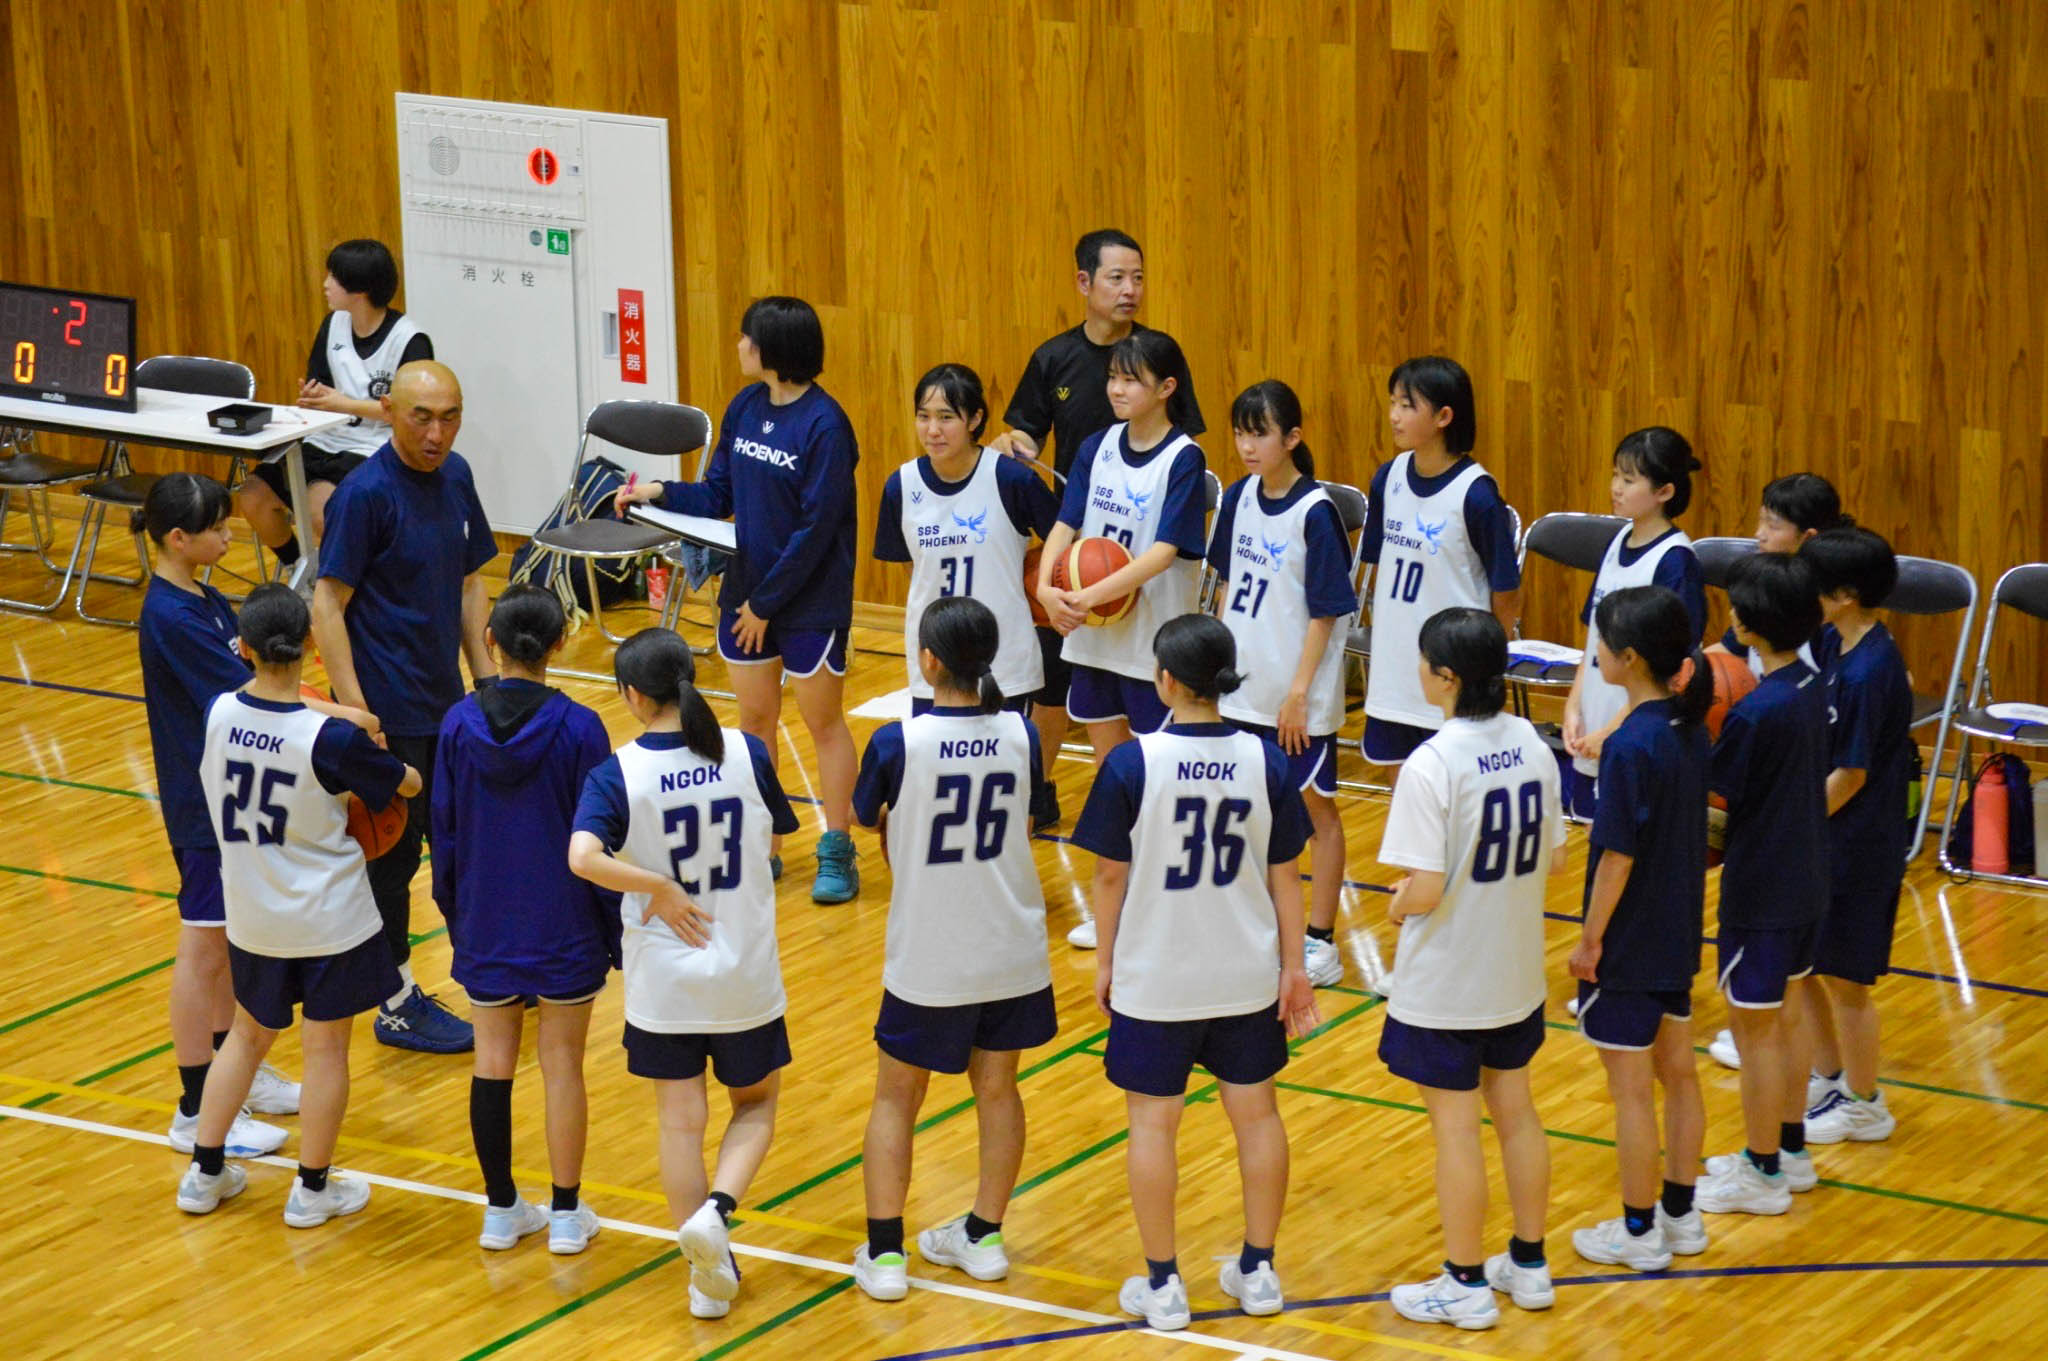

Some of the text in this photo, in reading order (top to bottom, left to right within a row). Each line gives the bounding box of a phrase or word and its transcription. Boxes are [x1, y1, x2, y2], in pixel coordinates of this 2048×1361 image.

[462, 264, 536, 287] 消火栓
[64, 300, 87, 346] 2
[623, 301, 642, 372] 消火器
[15, 341, 36, 384] 0
[105, 354, 127, 396] 0
[733, 437, 799, 471] PHOENIX
[1091, 497, 1131, 518] PHOENIX
[919, 534, 968, 549] PHOENIX
[939, 556, 974, 597] 31
[1230, 571, 1269, 619] 21
[1390, 558, 1424, 603] 10
[228, 726, 285, 754] NGOK
[939, 738, 1000, 759] NGOK
[1477, 746, 1525, 775] NGOK
[659, 763, 723, 793] NGOK
[1176, 761, 1238, 782] NGOK
[222, 758, 297, 847] 25
[926, 772, 1017, 867] 26
[662, 796, 744, 895] 23
[1164, 796, 1253, 891] 36
[1471, 780, 1543, 884] 88
